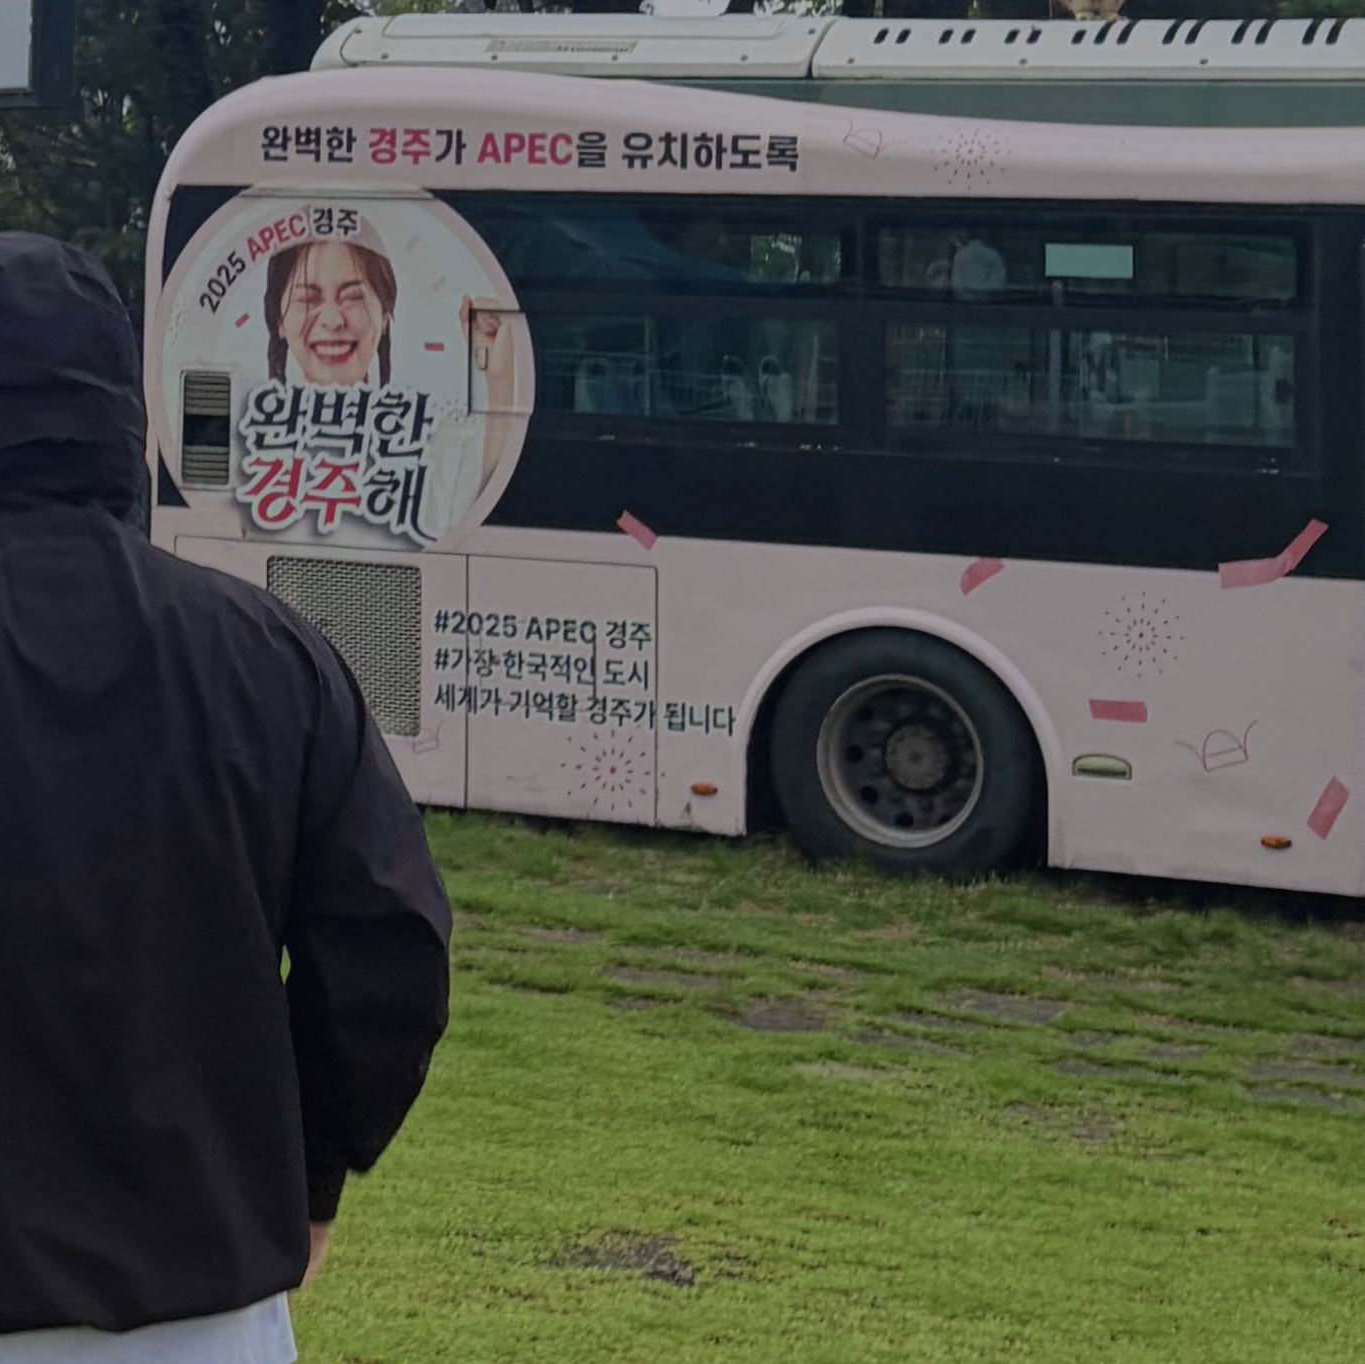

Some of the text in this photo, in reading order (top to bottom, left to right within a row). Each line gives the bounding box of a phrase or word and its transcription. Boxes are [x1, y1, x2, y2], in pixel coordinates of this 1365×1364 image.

[261, 126, 799, 173] 완벽한 경주가 APEC을 유치하도록
[199, 207, 358, 314] 2025 APEC 경주
[247, 385, 434, 458] 완벽한
[243, 456, 437, 542] 경주해
[434, 609, 652, 651] #2025 APEC 경주
[434, 647, 649, 691] #가장 한국적인 도시
[434, 682, 737, 737] 세계가 기억할 경주가 됩니다
